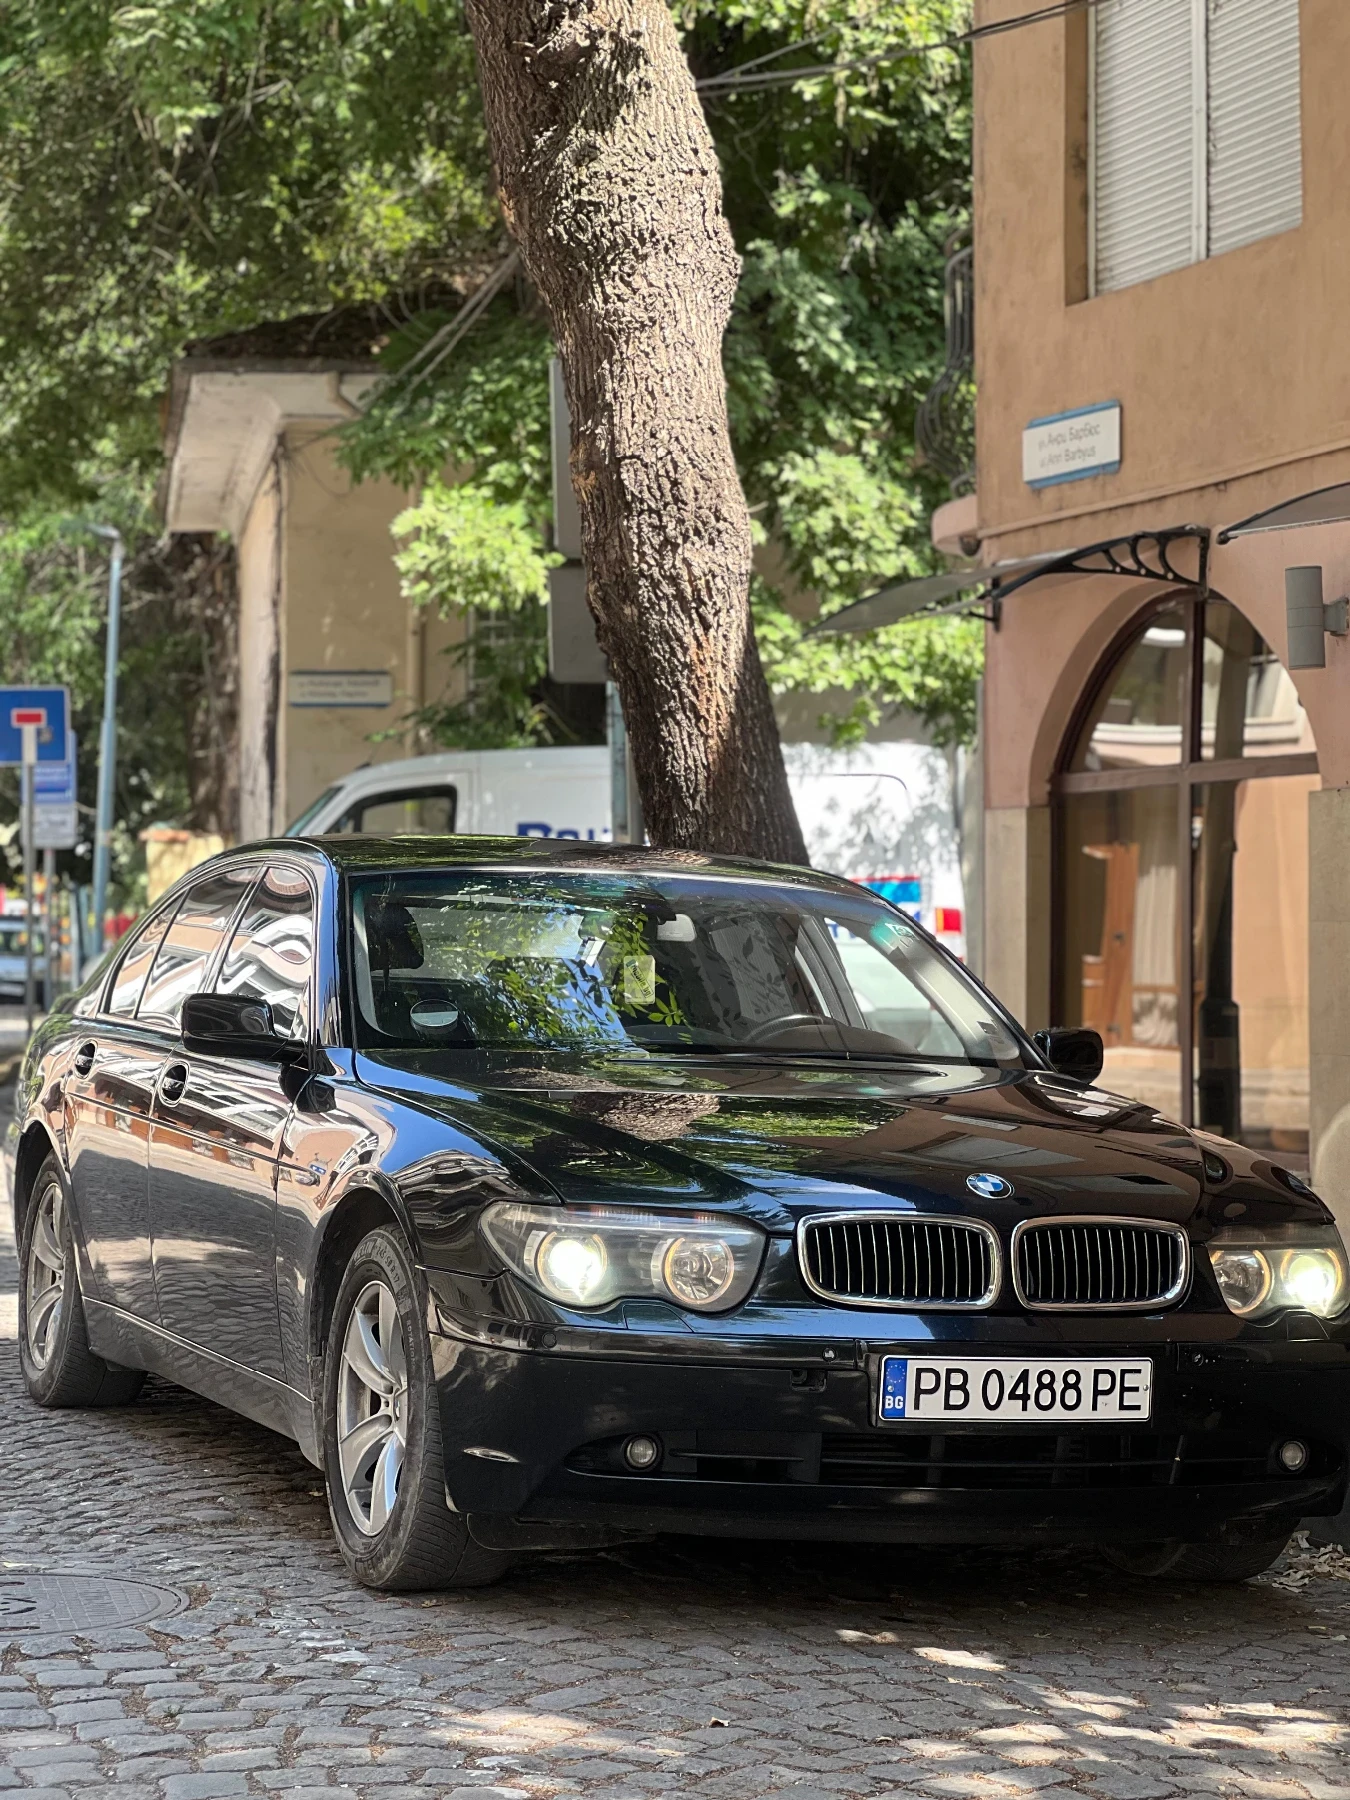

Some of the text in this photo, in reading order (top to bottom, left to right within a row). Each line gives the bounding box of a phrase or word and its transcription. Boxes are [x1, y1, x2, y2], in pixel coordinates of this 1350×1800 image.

[885, 1396, 903, 1409] BG
[914, 1367, 1142, 1412] PB 0488 PE
